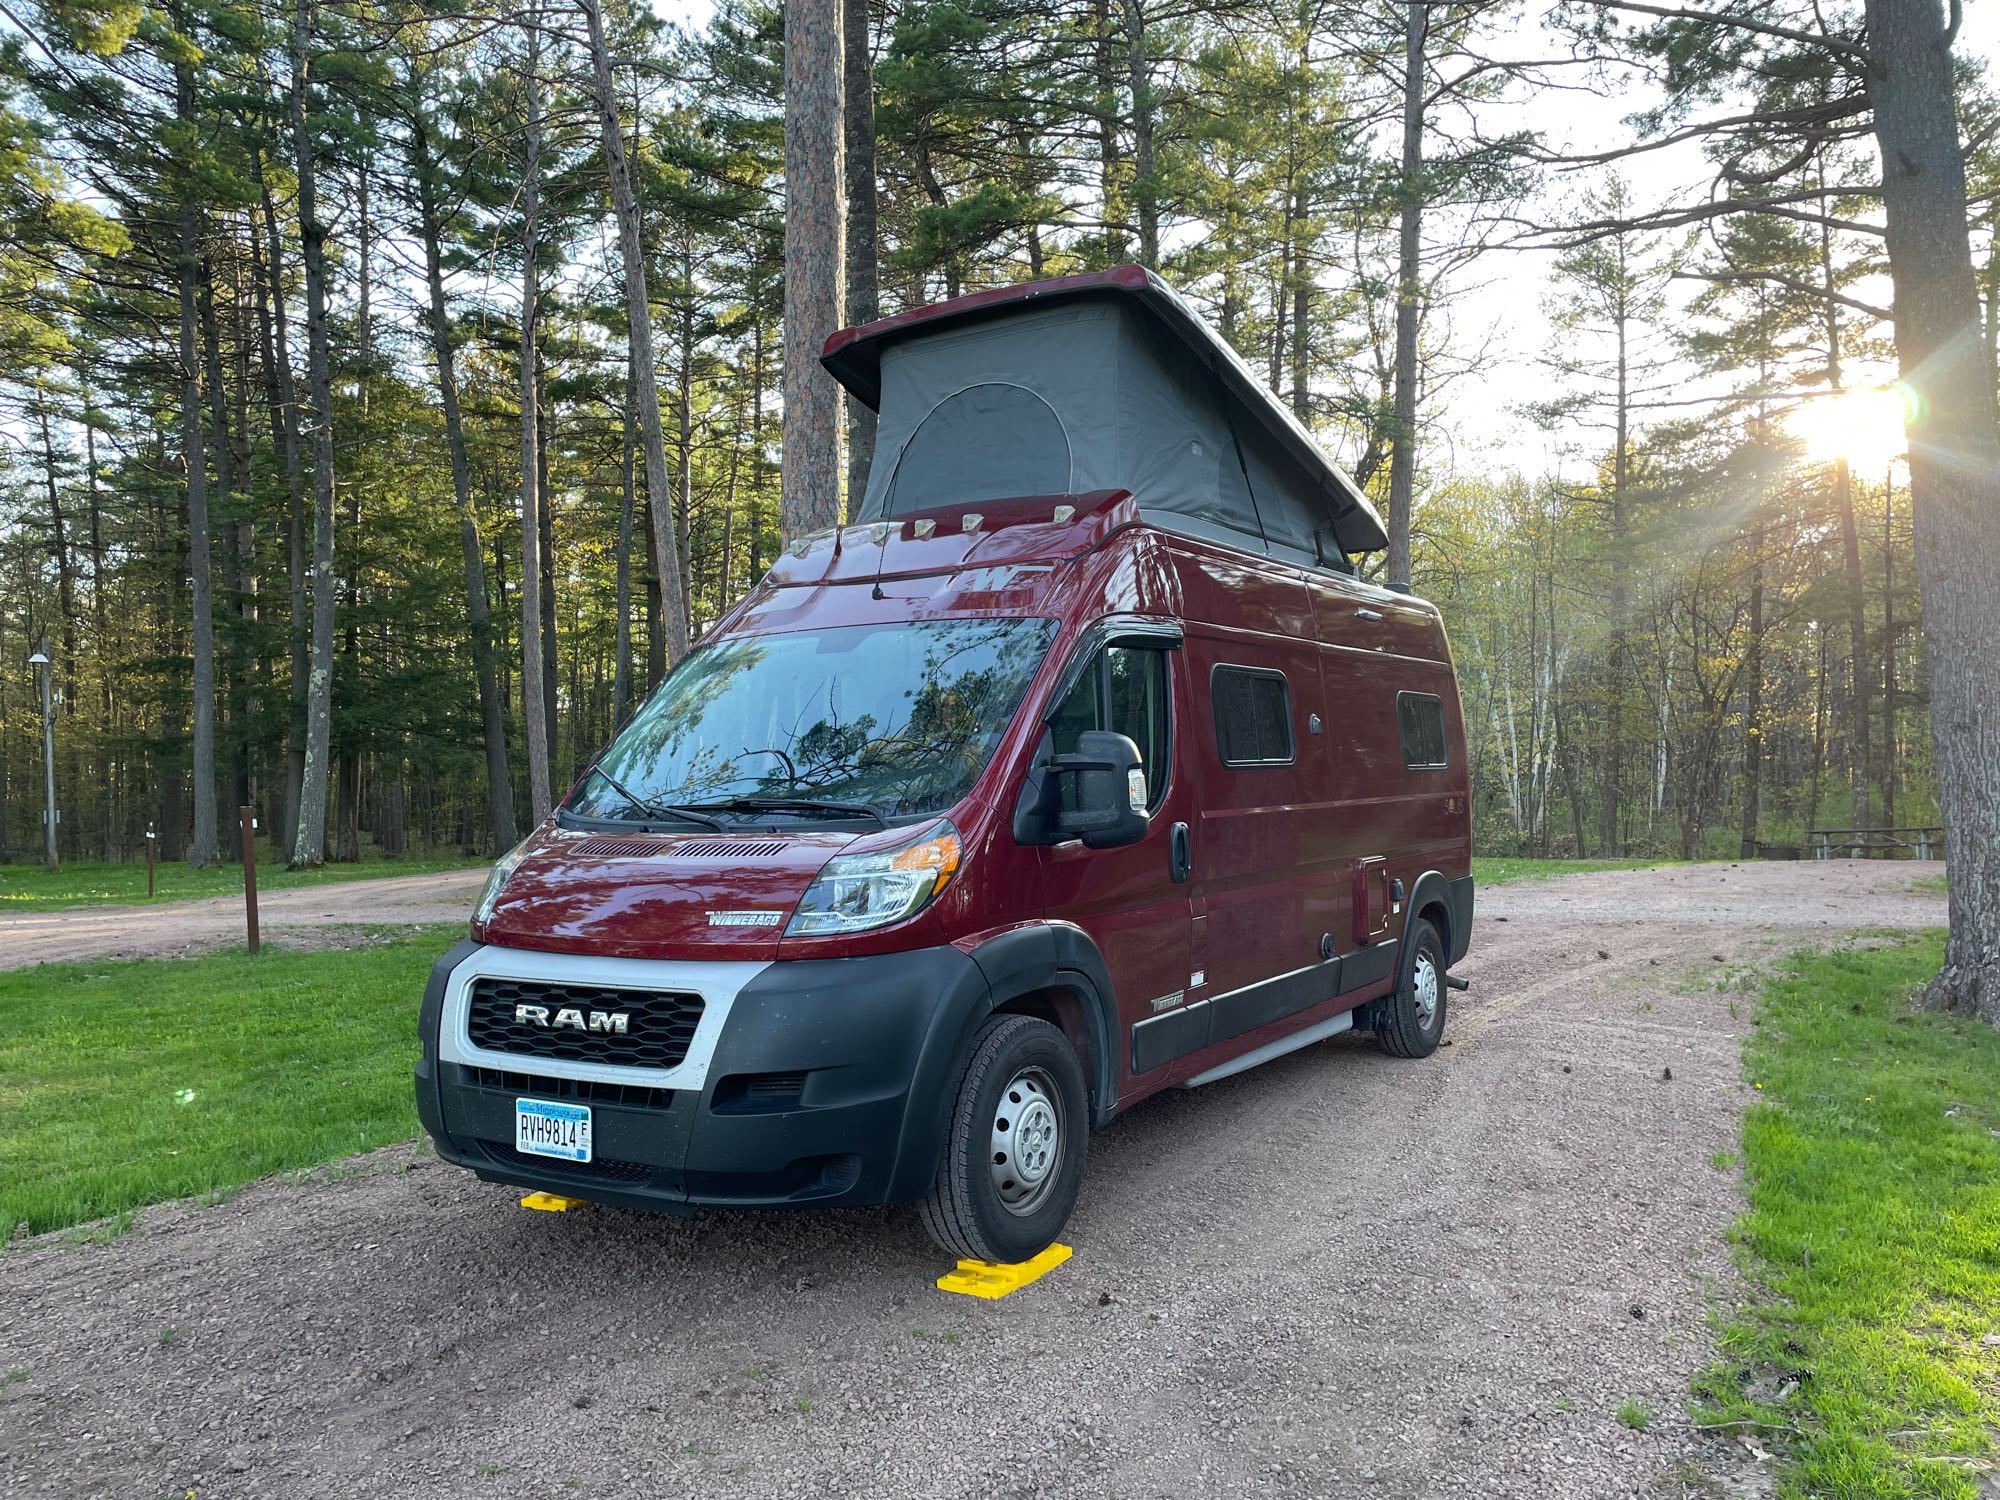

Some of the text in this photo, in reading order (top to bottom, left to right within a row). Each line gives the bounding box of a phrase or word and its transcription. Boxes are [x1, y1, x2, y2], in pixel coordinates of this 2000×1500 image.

[705, 911, 783, 926] WINNEBAGO
[516, 1004, 630, 1034] RAM
[521, 1115, 577, 1147] RVH9814
